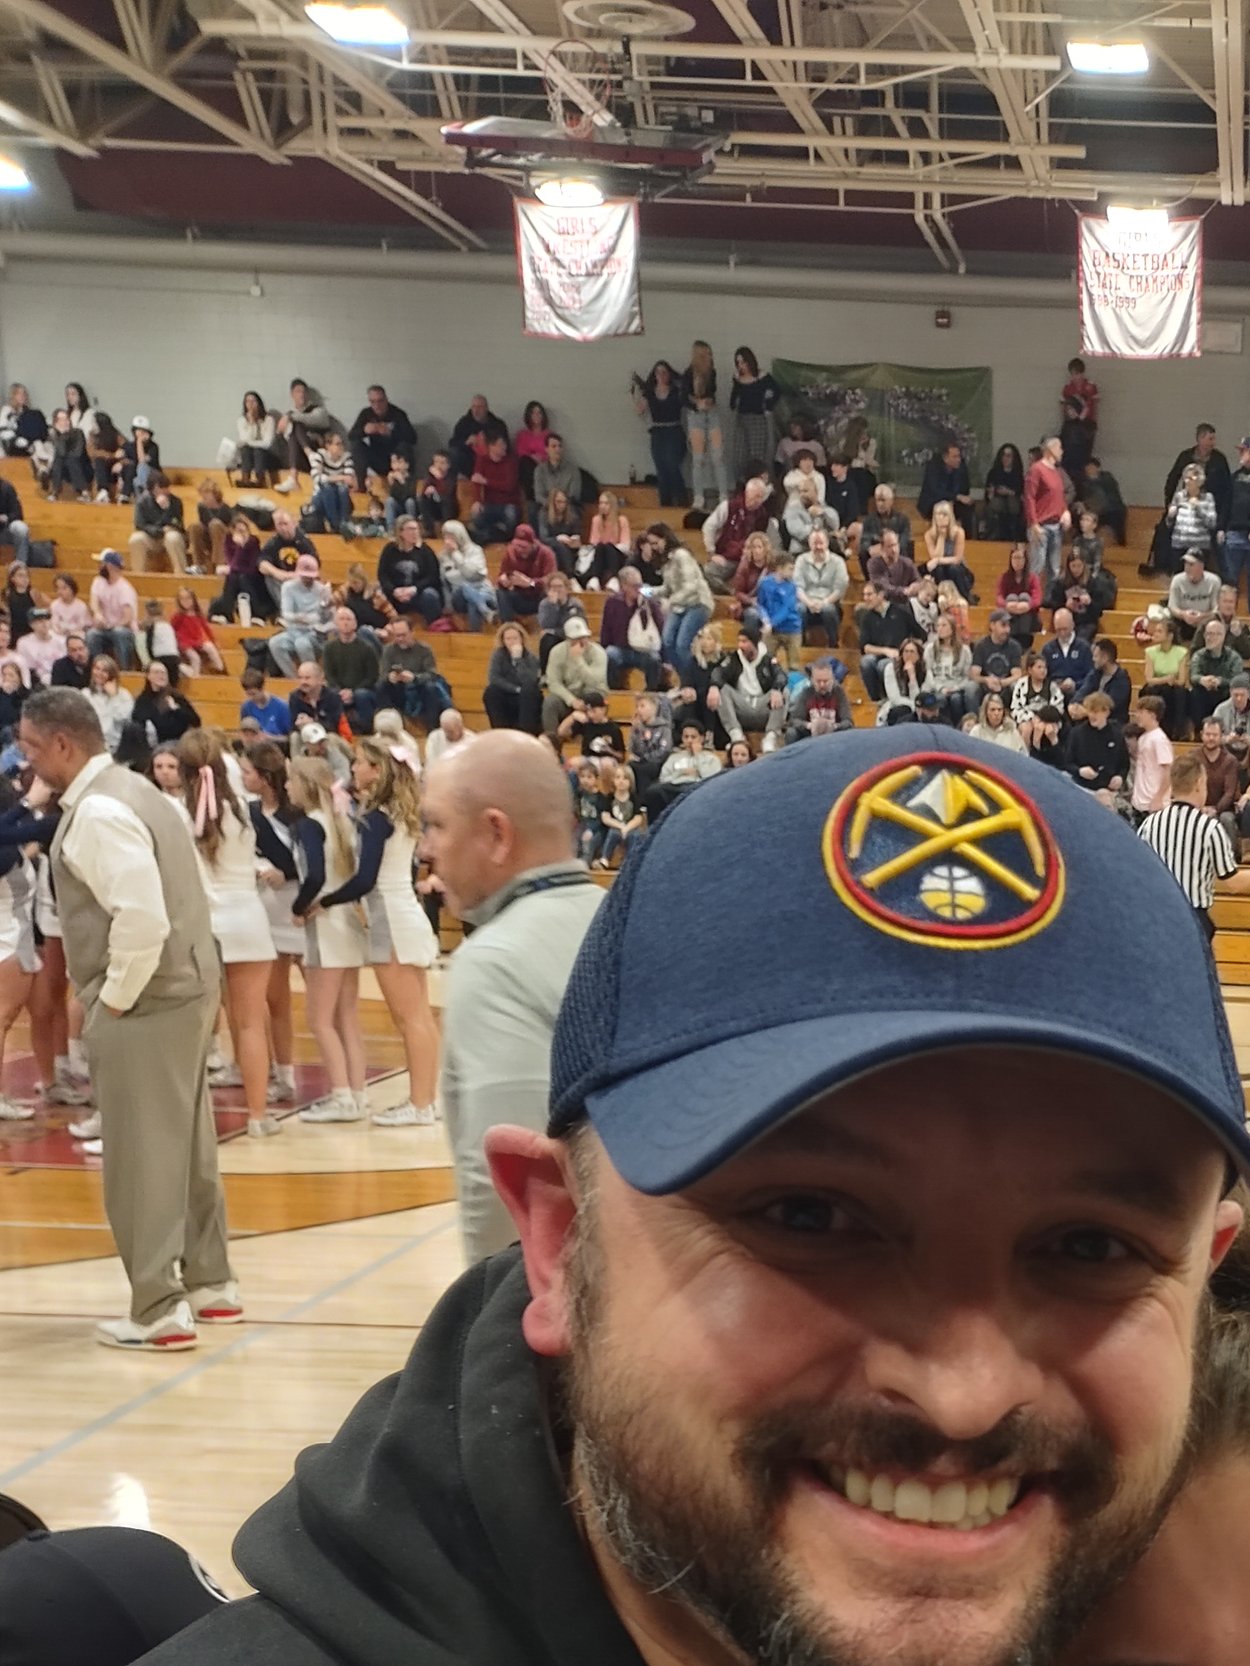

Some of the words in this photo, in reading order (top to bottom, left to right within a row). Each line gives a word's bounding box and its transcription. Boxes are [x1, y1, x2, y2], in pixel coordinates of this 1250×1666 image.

[1092, 249, 1188, 271] BASKETBALL
[1089, 271, 1121, 291] STATE
[1129, 274, 1191, 293] CHAMPIONS
